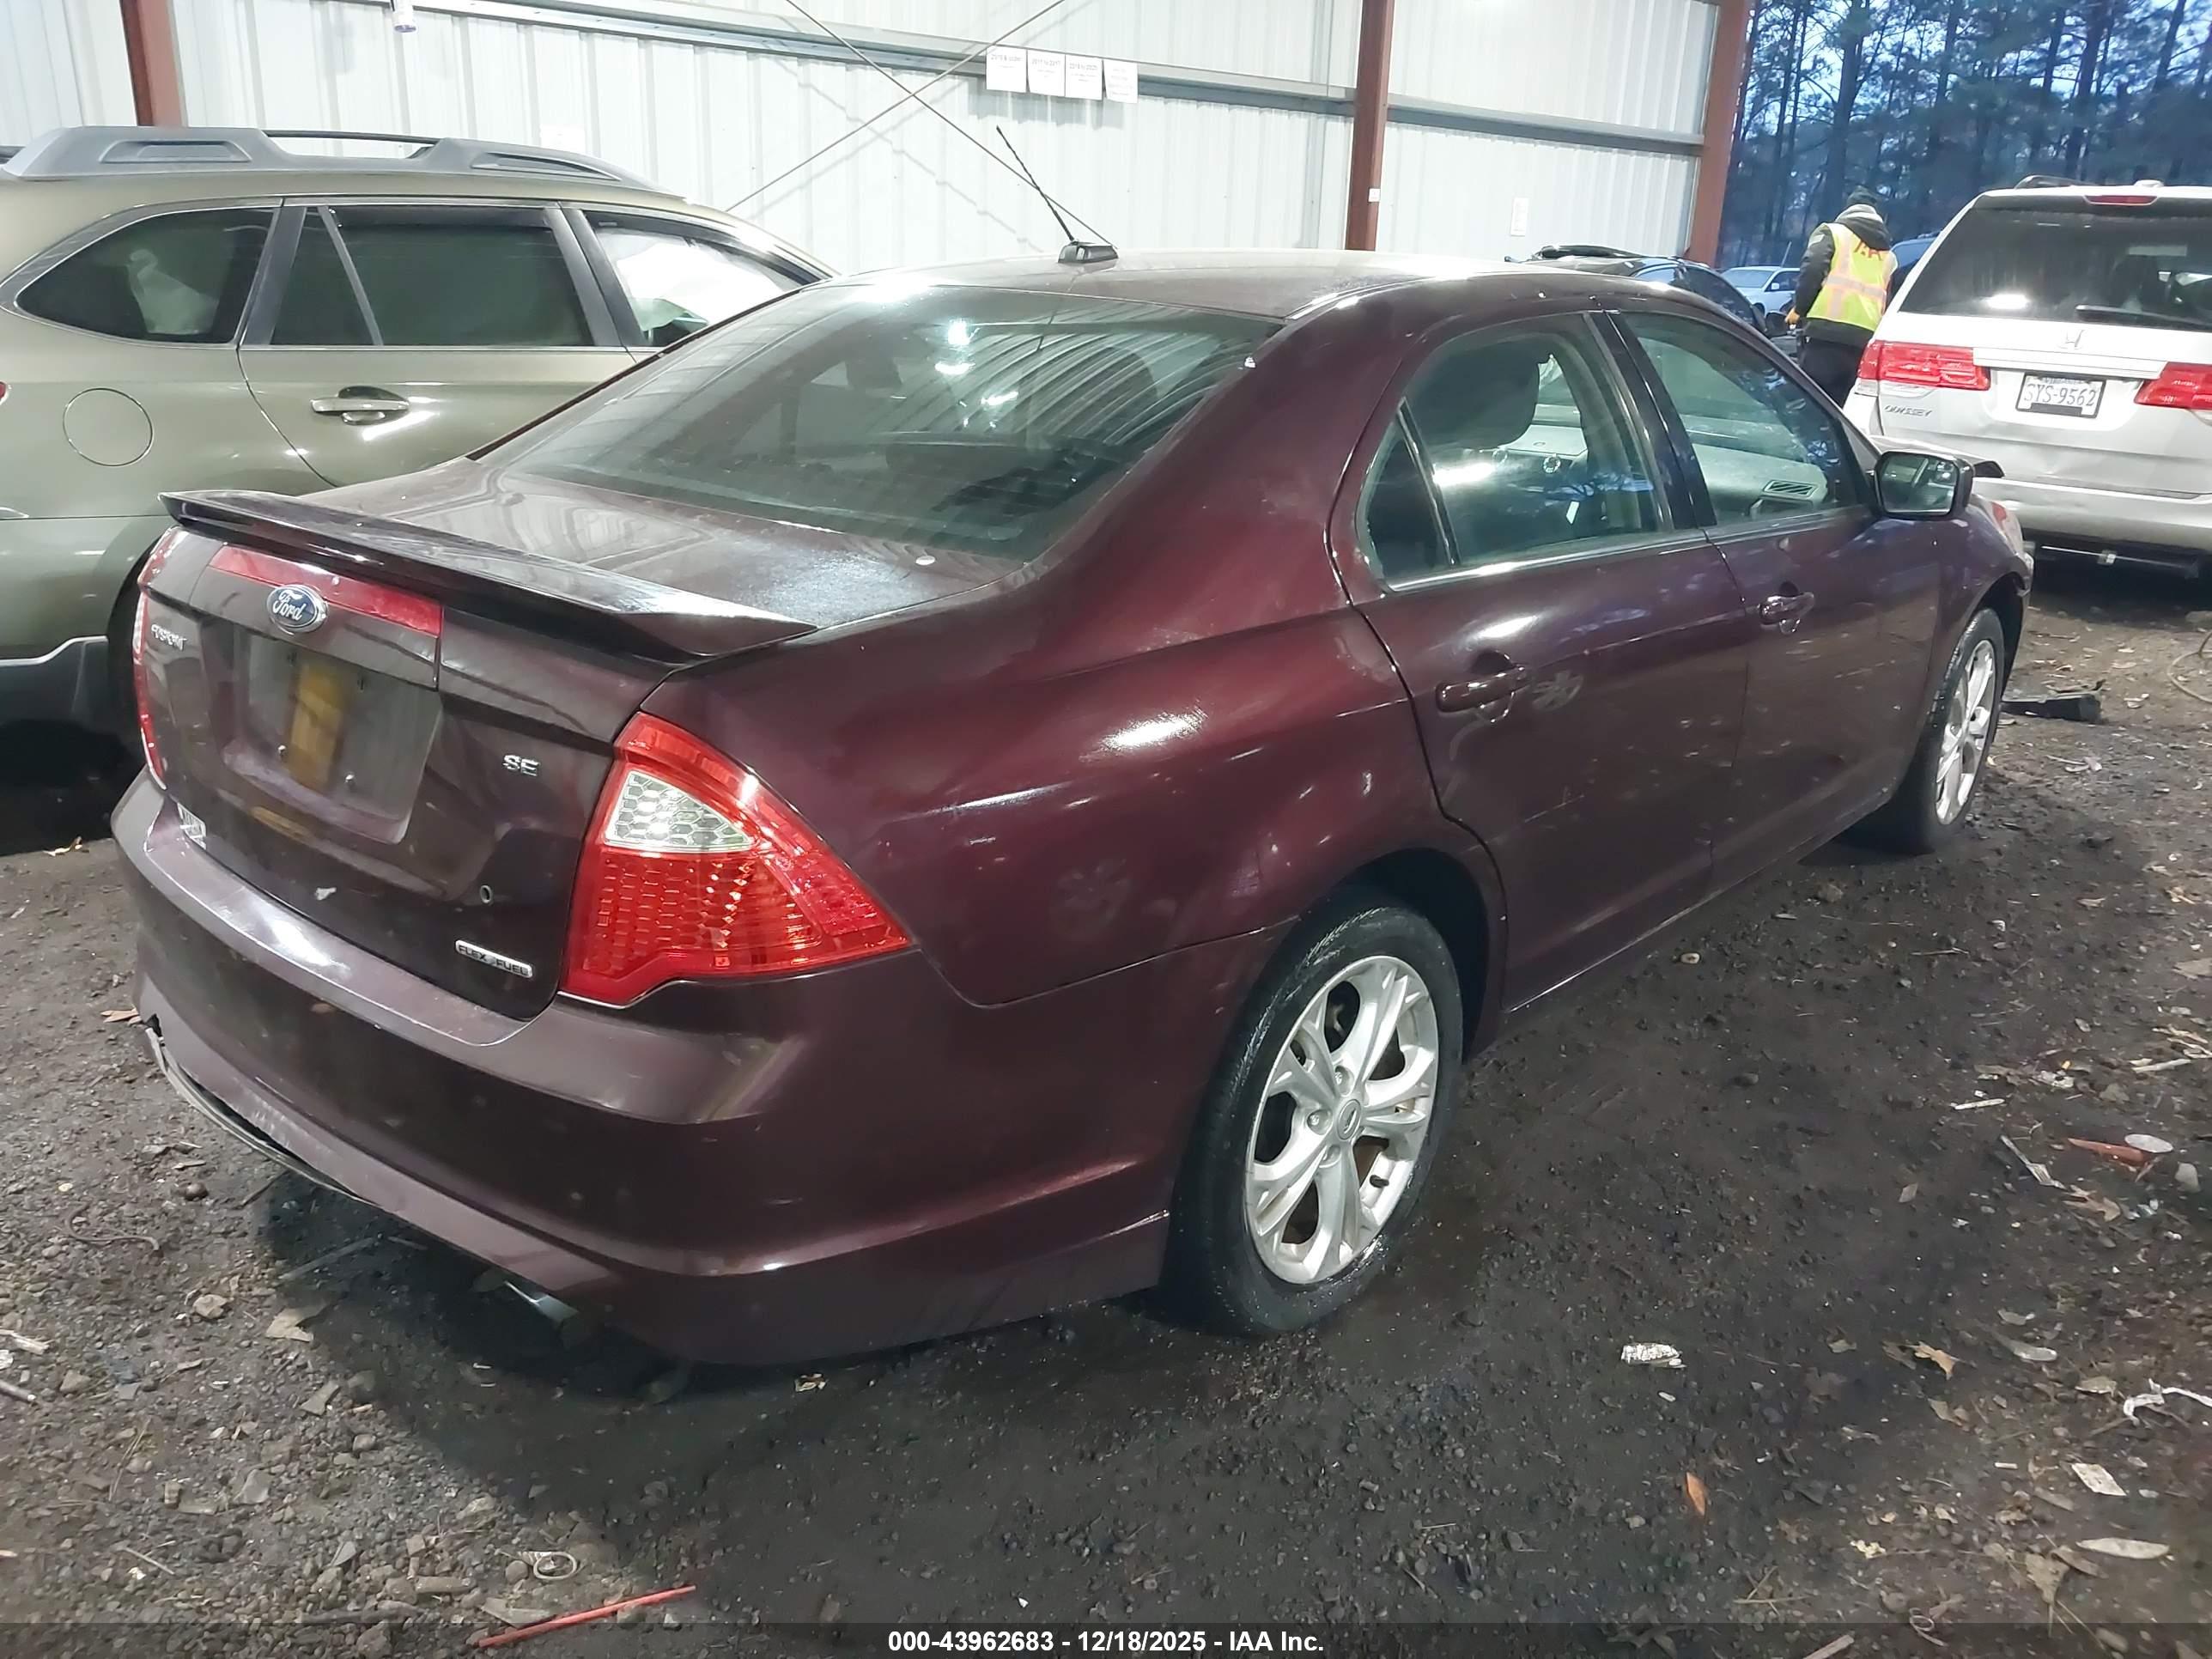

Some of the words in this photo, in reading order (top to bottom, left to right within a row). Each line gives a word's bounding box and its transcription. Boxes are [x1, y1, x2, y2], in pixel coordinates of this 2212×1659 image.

[2023, 383, 2097, 406] SYS-9562
[272, 589, 307, 622] Ford
[502, 755, 540, 776] SE
[458, 944, 487, 963] FLEX
[495, 957, 530, 976] FUEL
